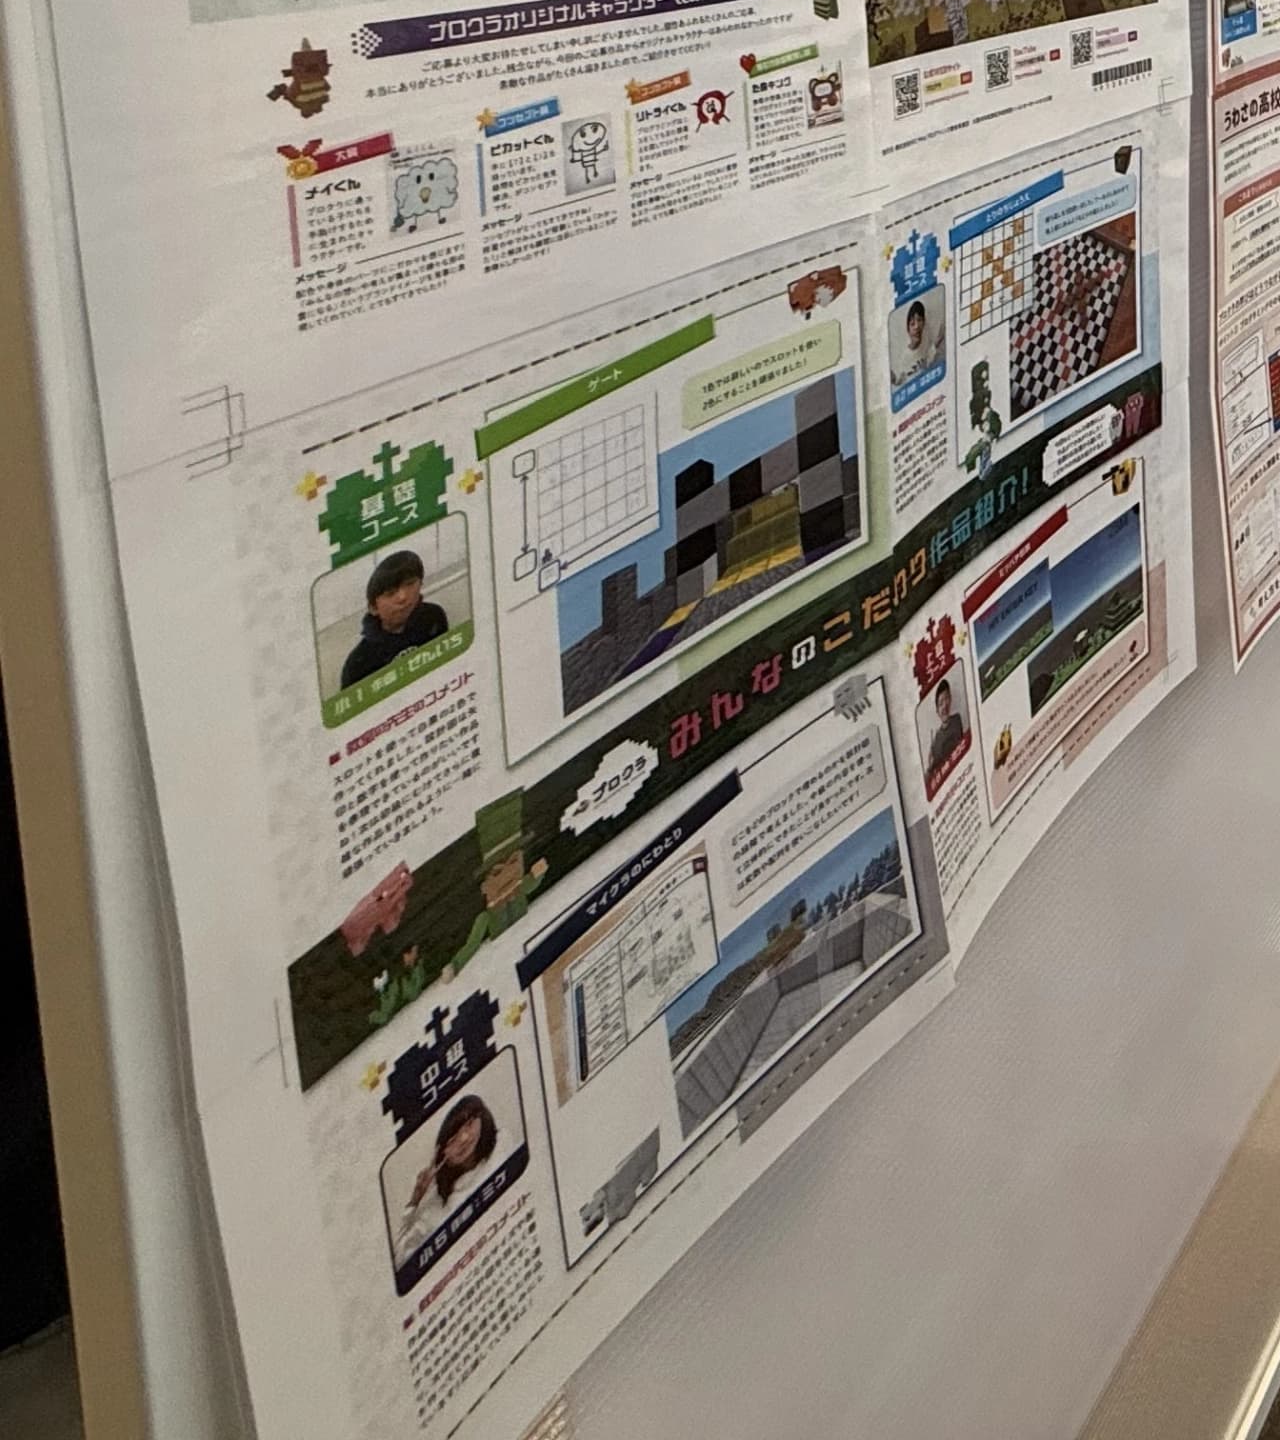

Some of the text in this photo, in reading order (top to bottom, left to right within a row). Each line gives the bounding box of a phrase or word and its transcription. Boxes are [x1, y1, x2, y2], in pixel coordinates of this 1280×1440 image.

[360, 477, 417, 520] 基礎
[360, 502, 420, 544] コース
[590, 755, 648, 804] プロクラ
[585, 824, 684, 917] マイクラのにわとり
[421, 1064, 469, 1110] コース
